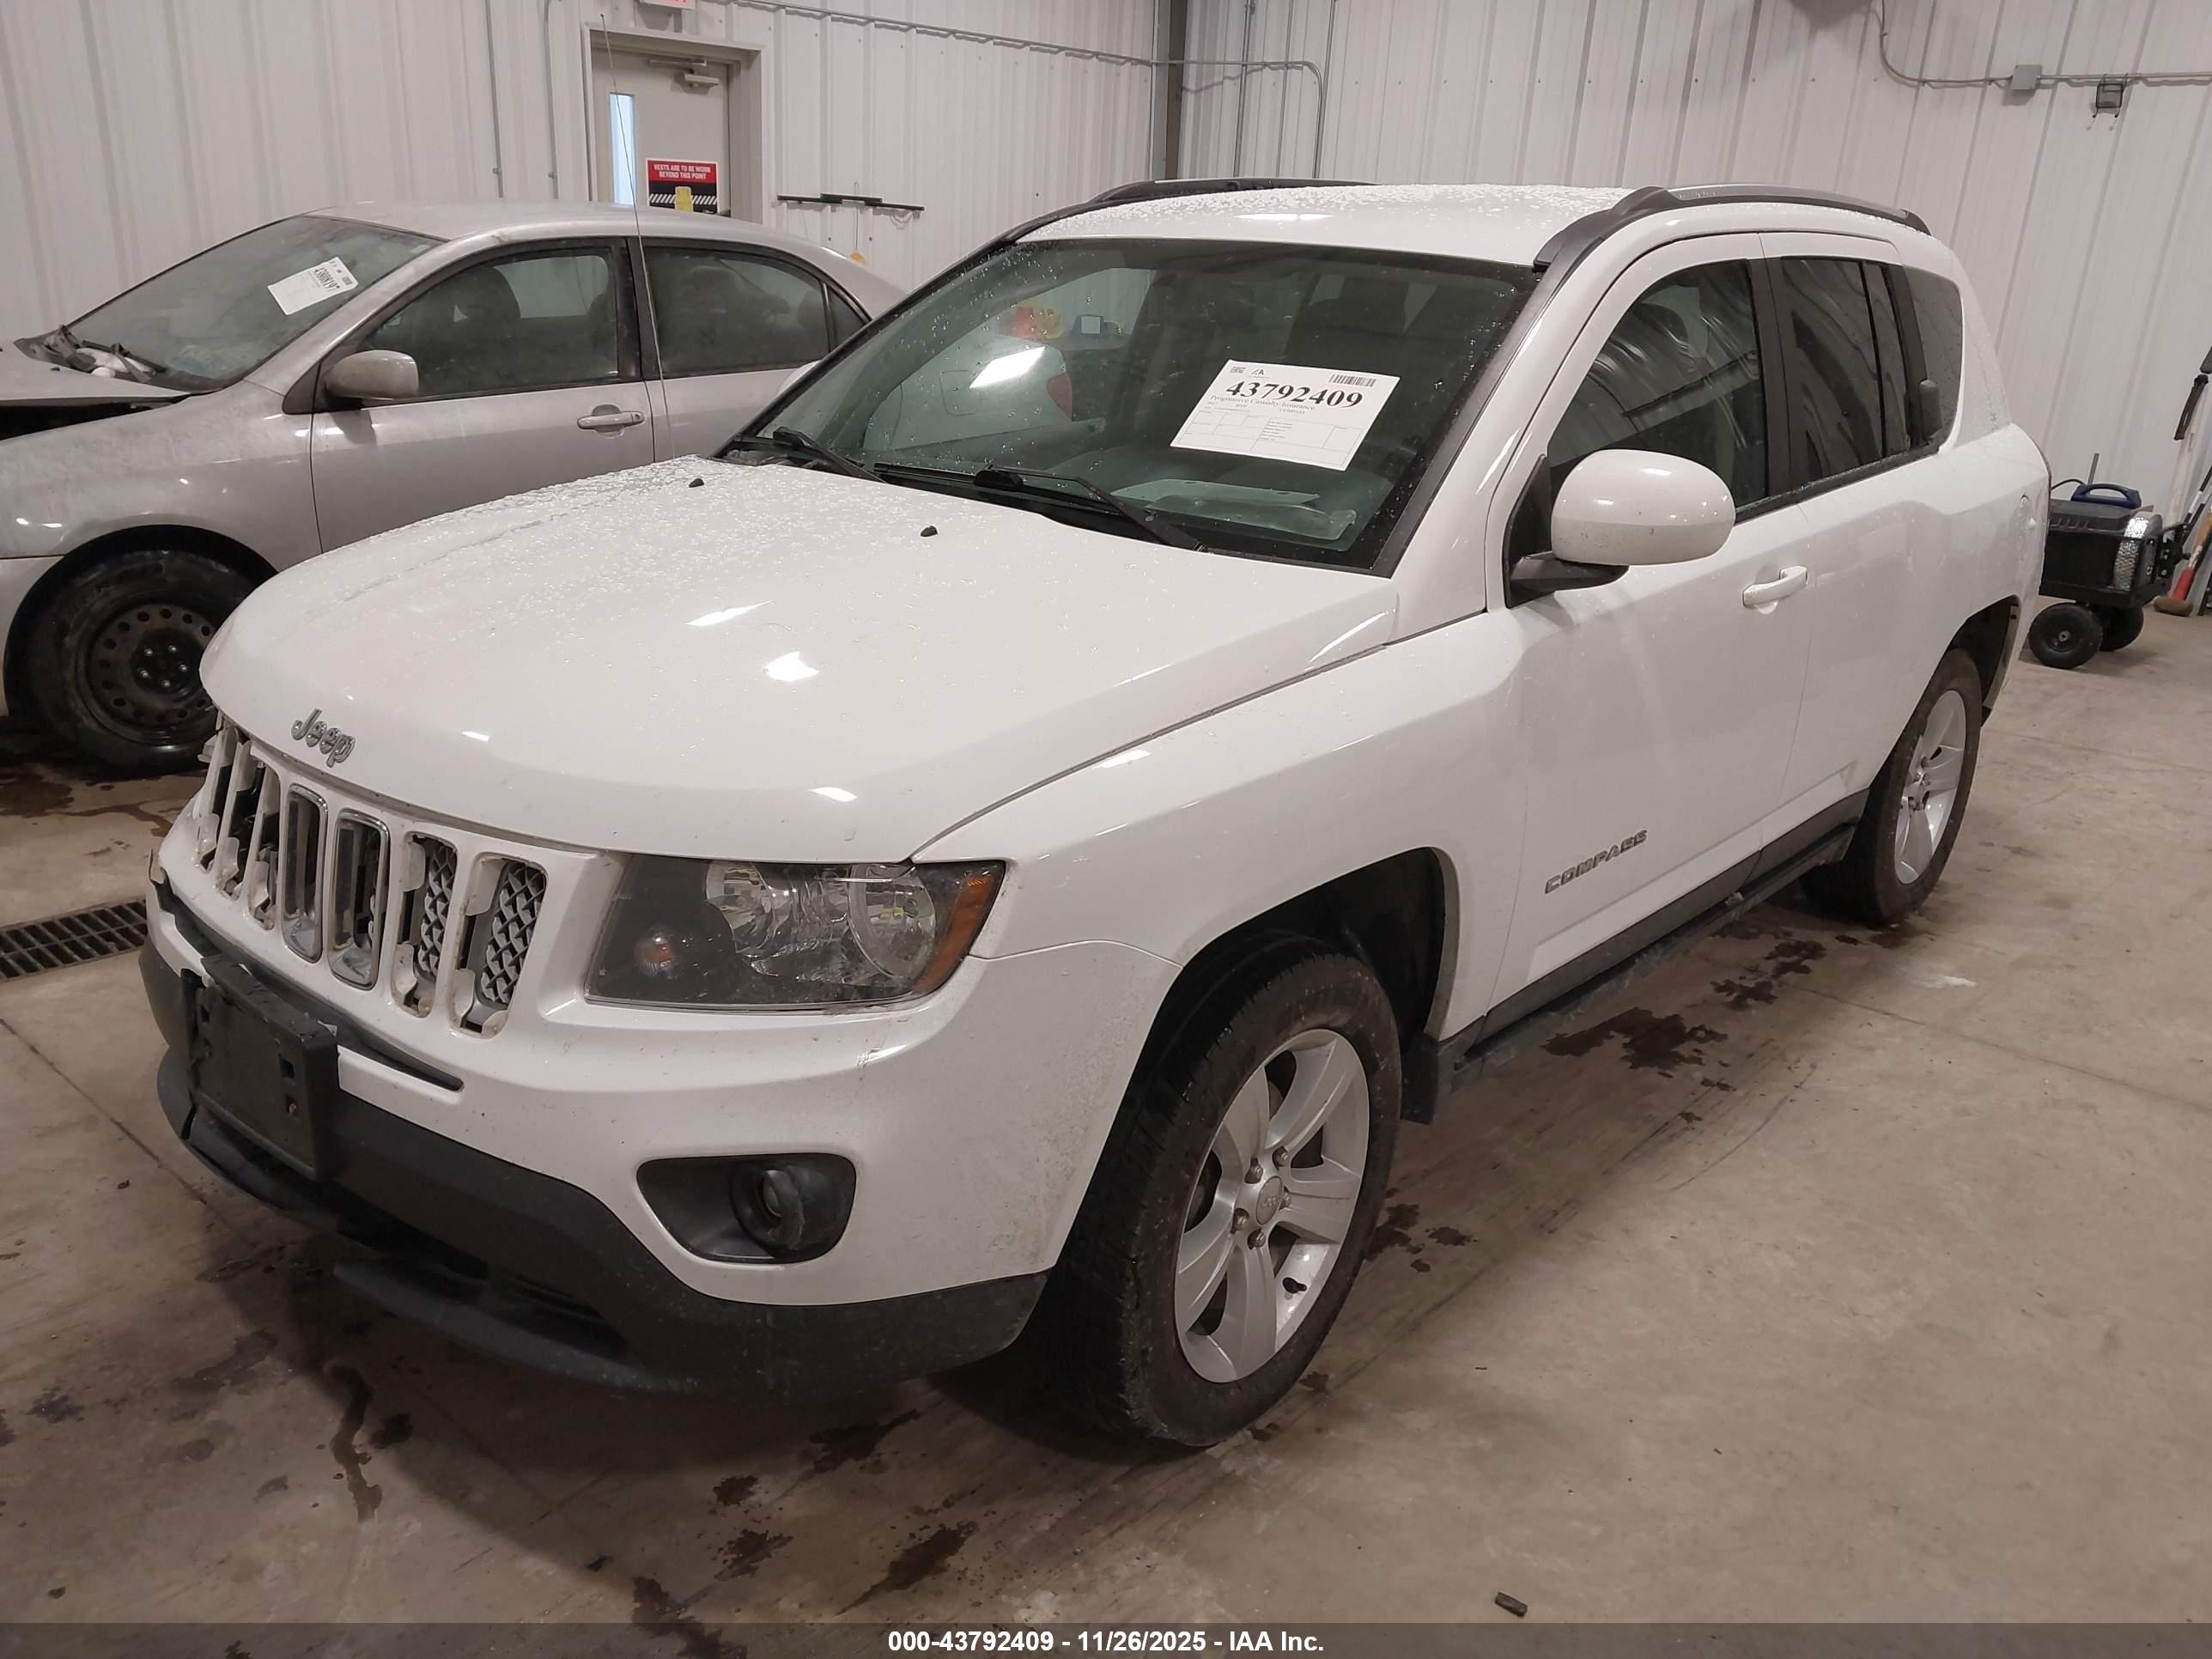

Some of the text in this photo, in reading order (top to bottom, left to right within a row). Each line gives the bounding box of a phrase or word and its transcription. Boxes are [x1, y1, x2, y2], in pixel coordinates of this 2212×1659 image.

[1225, 380, 1364, 408] 43792409
[291, 708, 356, 769] Jeep
[1545, 830, 1647, 894] COMPASS
